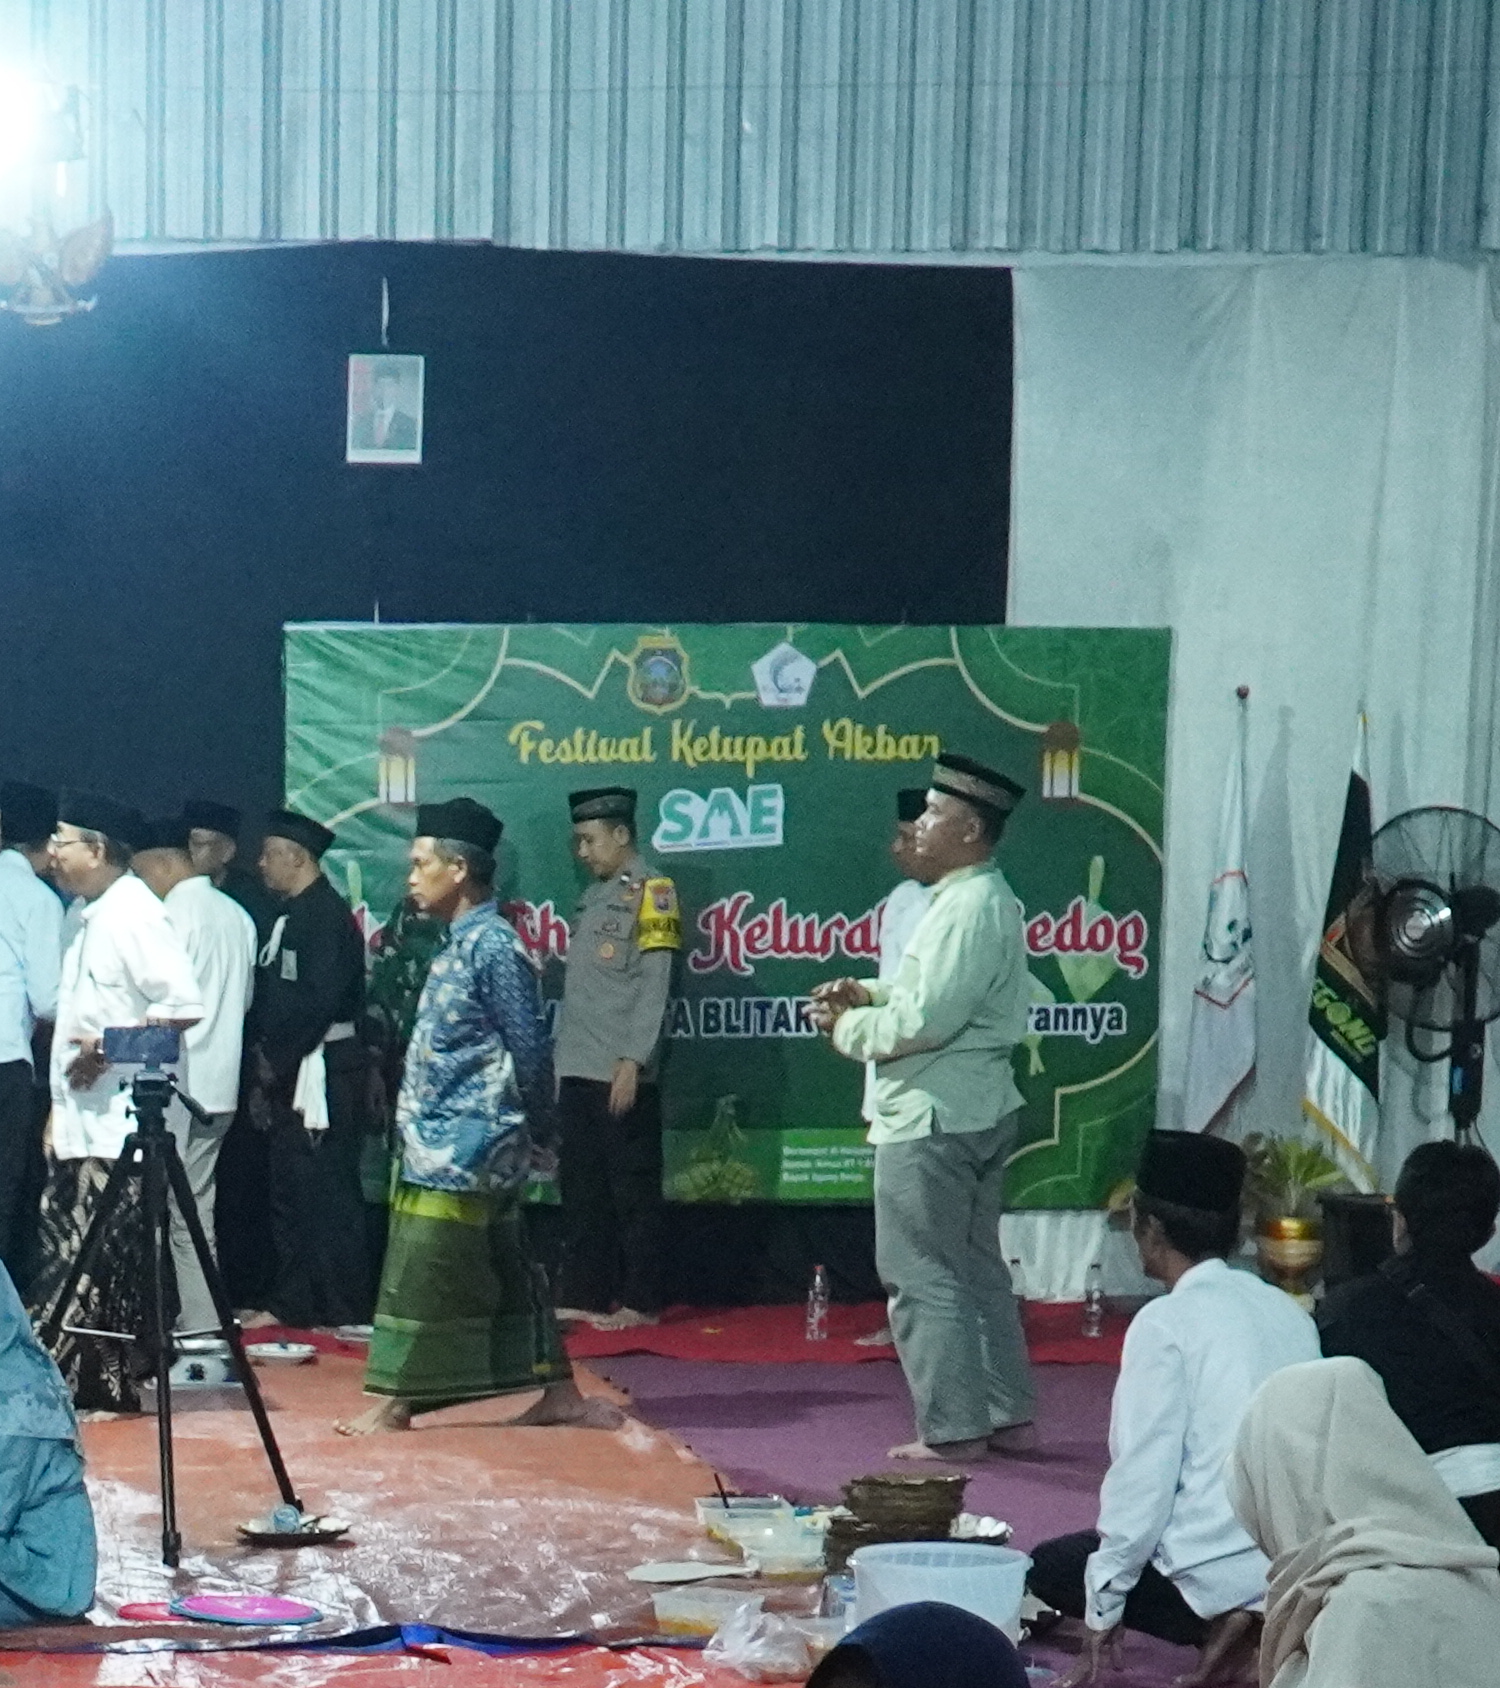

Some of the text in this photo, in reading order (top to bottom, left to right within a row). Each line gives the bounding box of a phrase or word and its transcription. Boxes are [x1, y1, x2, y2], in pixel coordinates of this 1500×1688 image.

[508, 719, 658, 765] Festival
[822, 717, 945, 762] Akbar
[655, 785, 783, 848] SAE
[689, 892, 1149, 979] Kelura edog
[1027, 1002, 1127, 1044] annya
